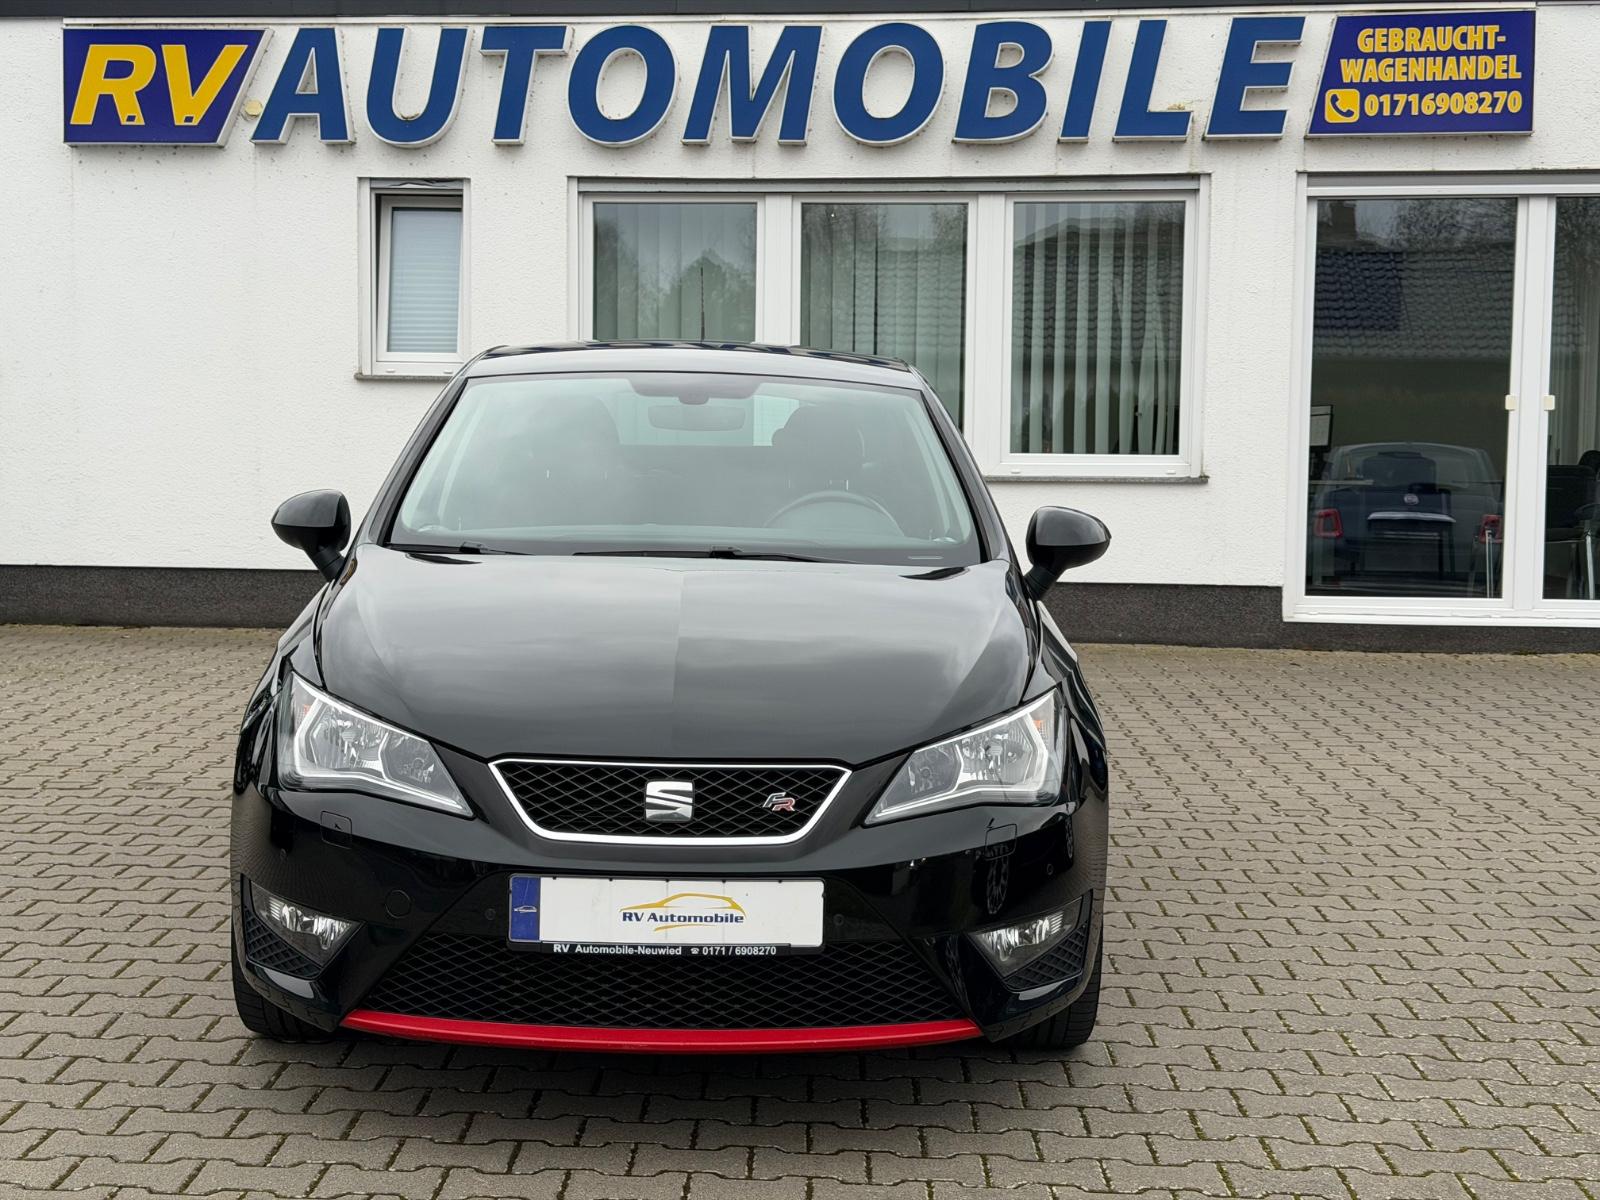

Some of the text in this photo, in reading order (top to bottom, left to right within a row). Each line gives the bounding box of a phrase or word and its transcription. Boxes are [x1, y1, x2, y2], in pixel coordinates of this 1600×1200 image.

[1357, 25, 1507, 53] GEBRAUCHT-
[250, 15, 1305, 147] AUTOMOBILE
[1340, 55, 1522, 83] WAGENHANDEL
[1364, 91, 1523, 116] 01716908270
[762, 791, 797, 812] FR
[622, 911, 744, 924] RV Automobile
[553, 944, 570, 954] RV
[575, 945, 682, 956] Automobile-Neuwied
[702, 947, 726, 956] 0171
[734, 947, 777, 956] 6908270
